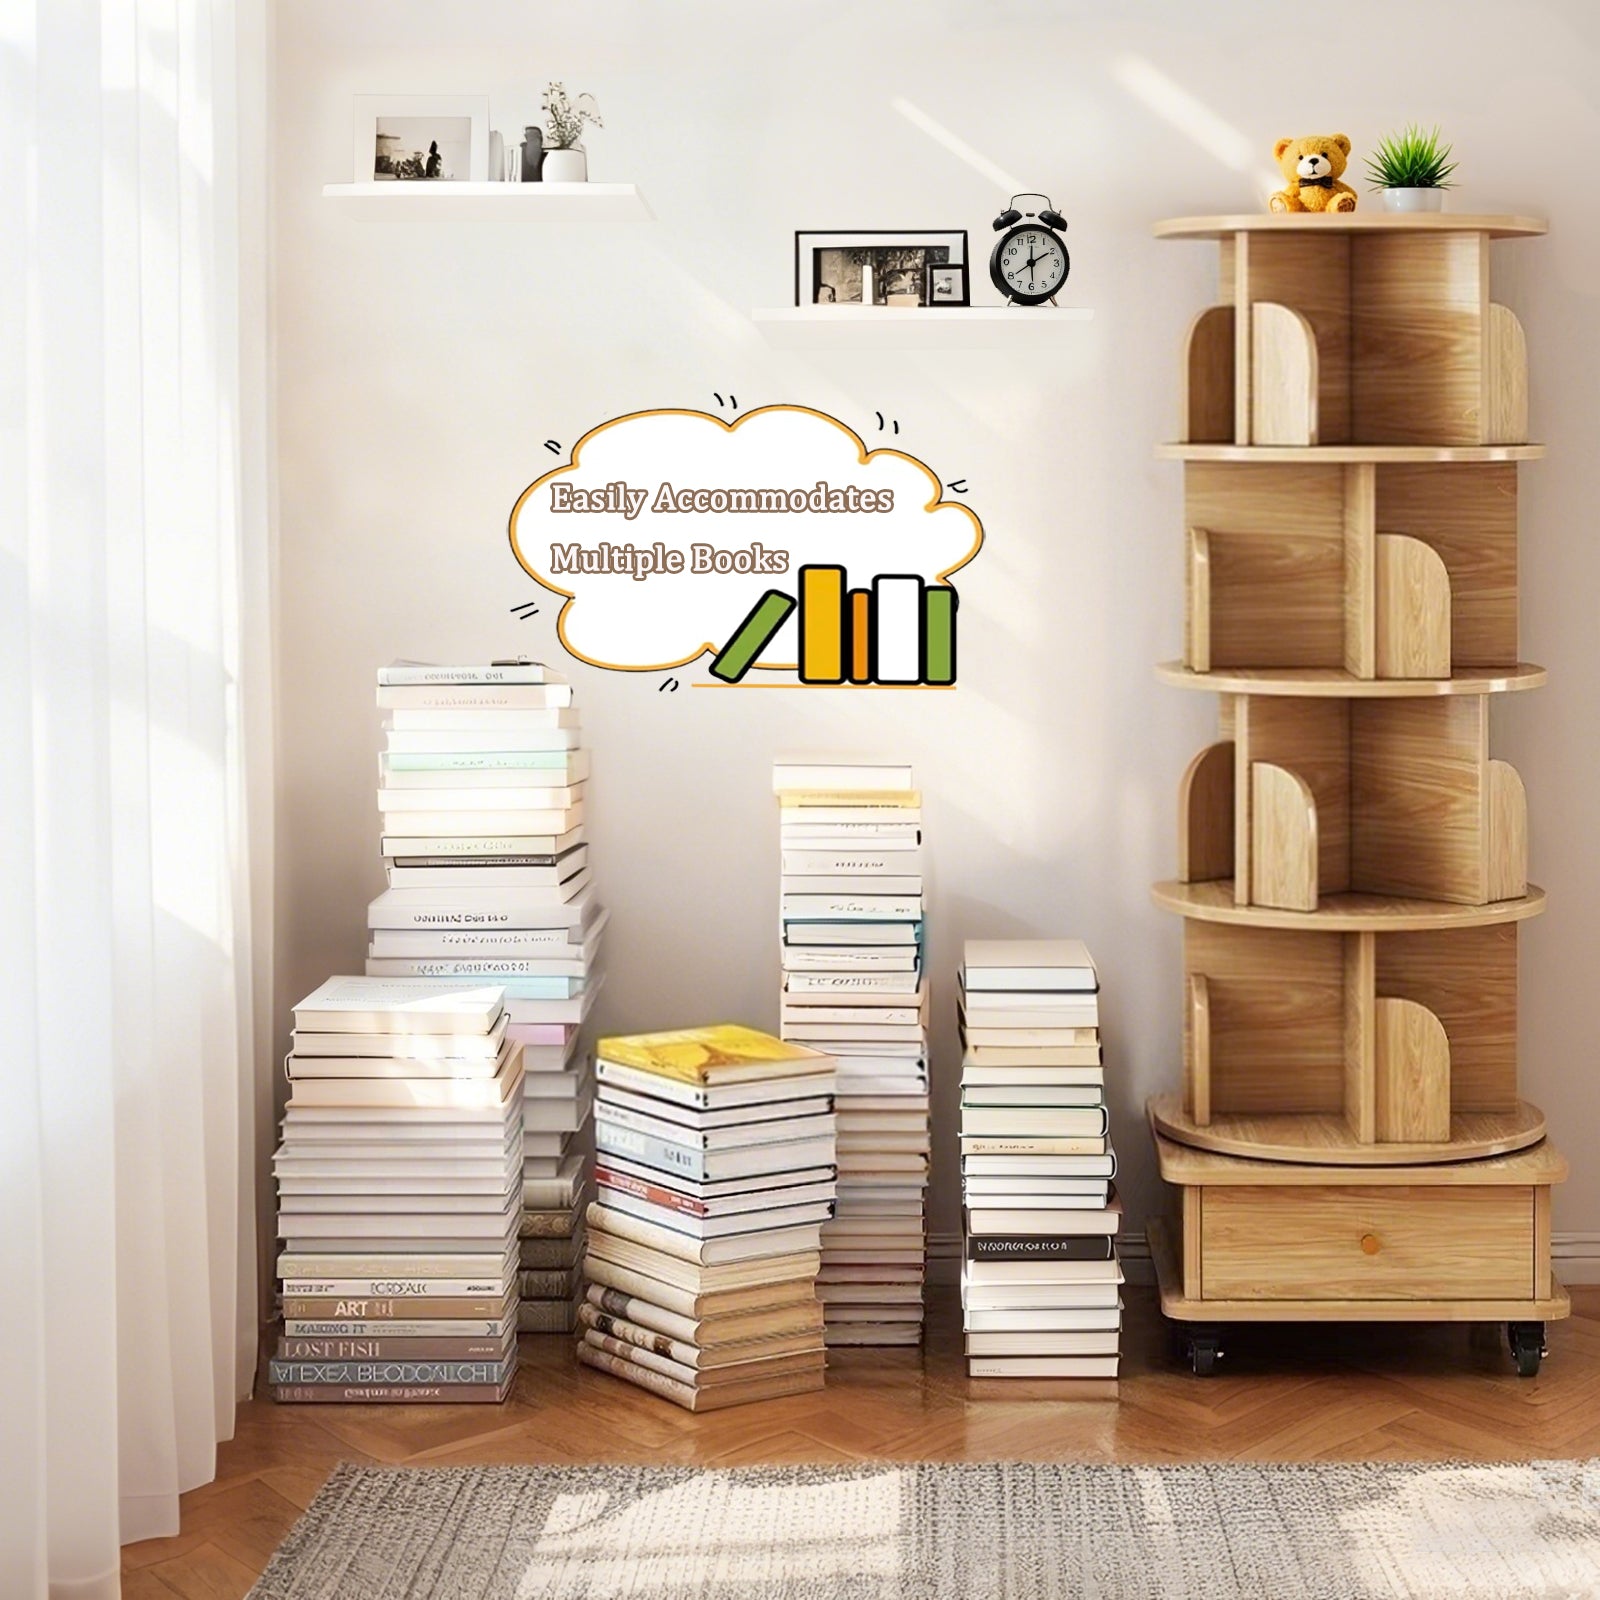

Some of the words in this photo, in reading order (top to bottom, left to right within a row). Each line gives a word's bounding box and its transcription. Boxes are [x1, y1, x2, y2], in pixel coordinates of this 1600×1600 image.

[1027, 235, 1036, 244] 12
[1054, 259, 1060, 267] 3
[1028, 282, 1034, 290] 6
[334, 1301, 368, 1317] ART
[285, 1342, 334, 1358] LOST
[339, 1342, 380, 1358] FISH
